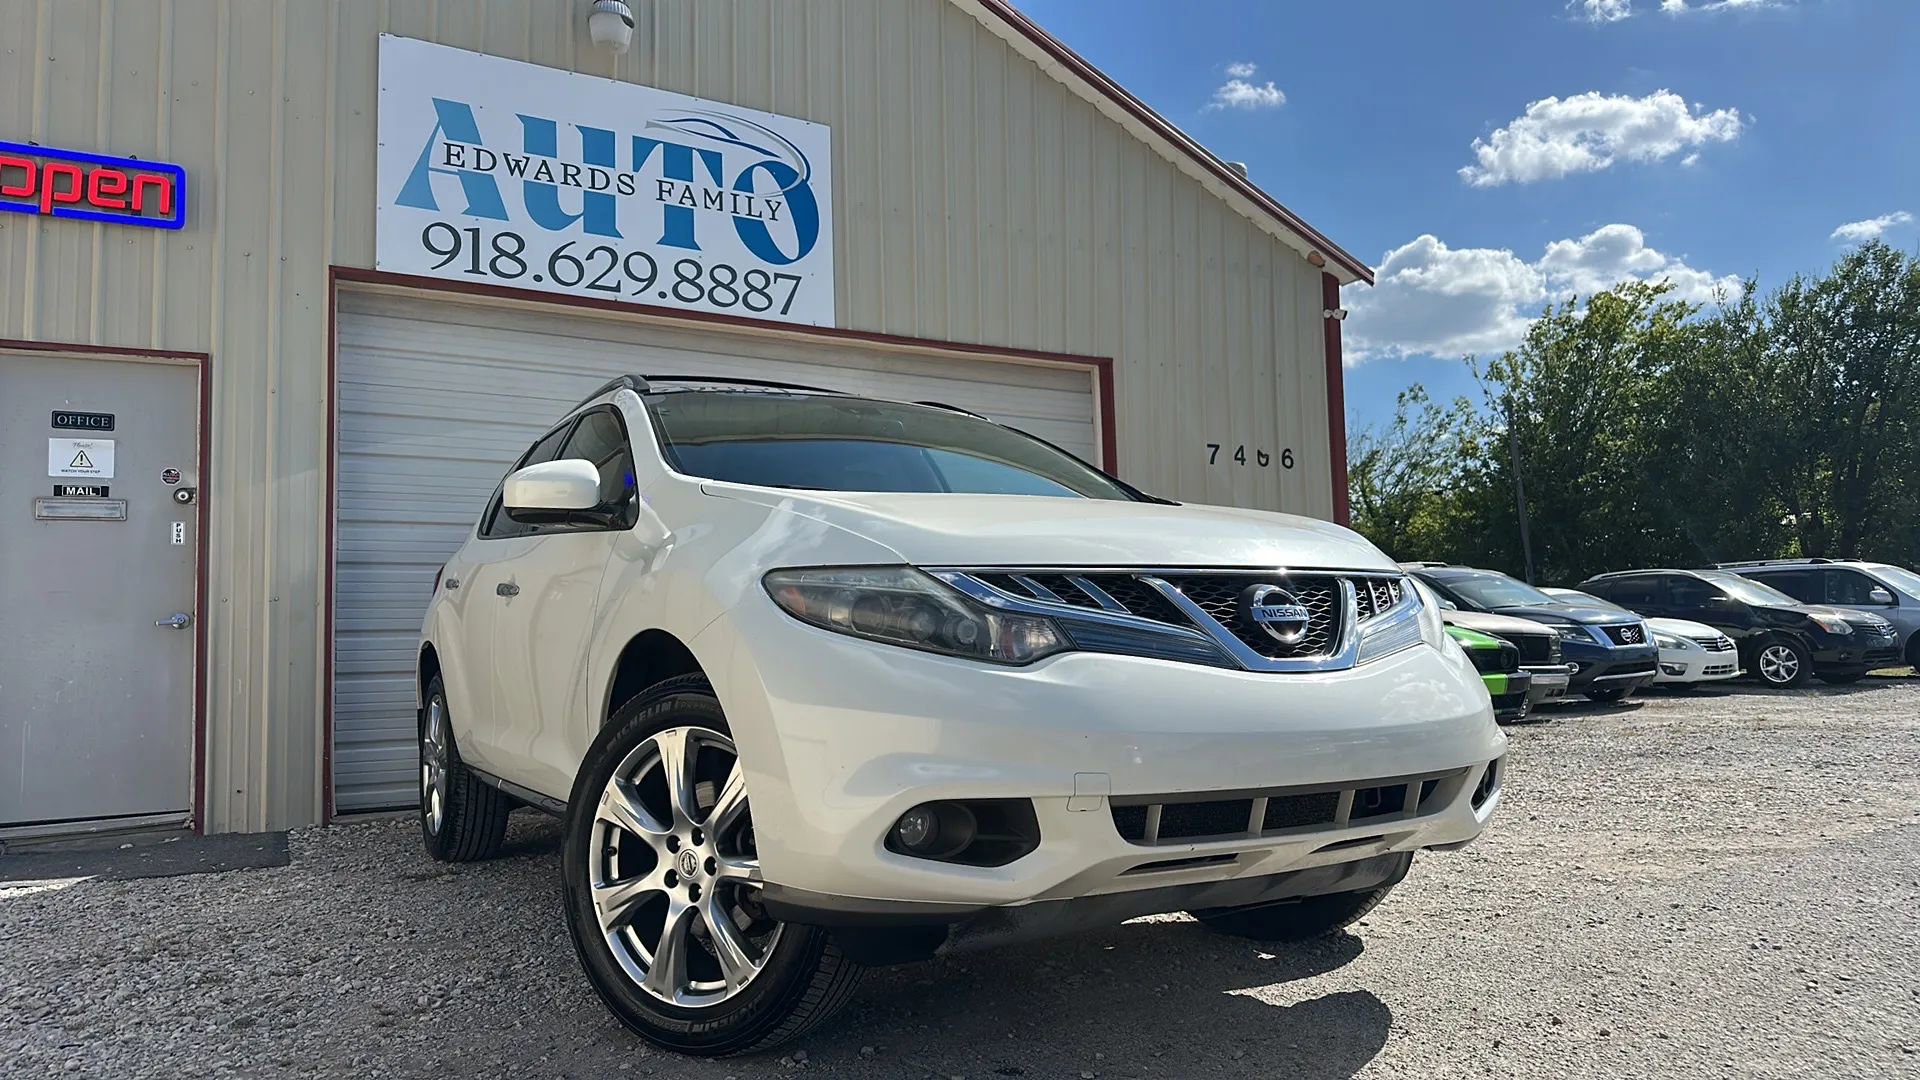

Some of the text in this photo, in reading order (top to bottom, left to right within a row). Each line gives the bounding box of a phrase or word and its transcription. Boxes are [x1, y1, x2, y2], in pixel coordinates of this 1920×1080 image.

[394, 97, 820, 266] AUTO
[443, 141, 783, 222] EDWARDS FAMILY
[421, 221, 802, 316] 918.629.8887
[57, 414, 110, 427] OFFICE
[66, 486, 97, 497] MAIL
[1262, 608, 1308, 618] NISSAN
